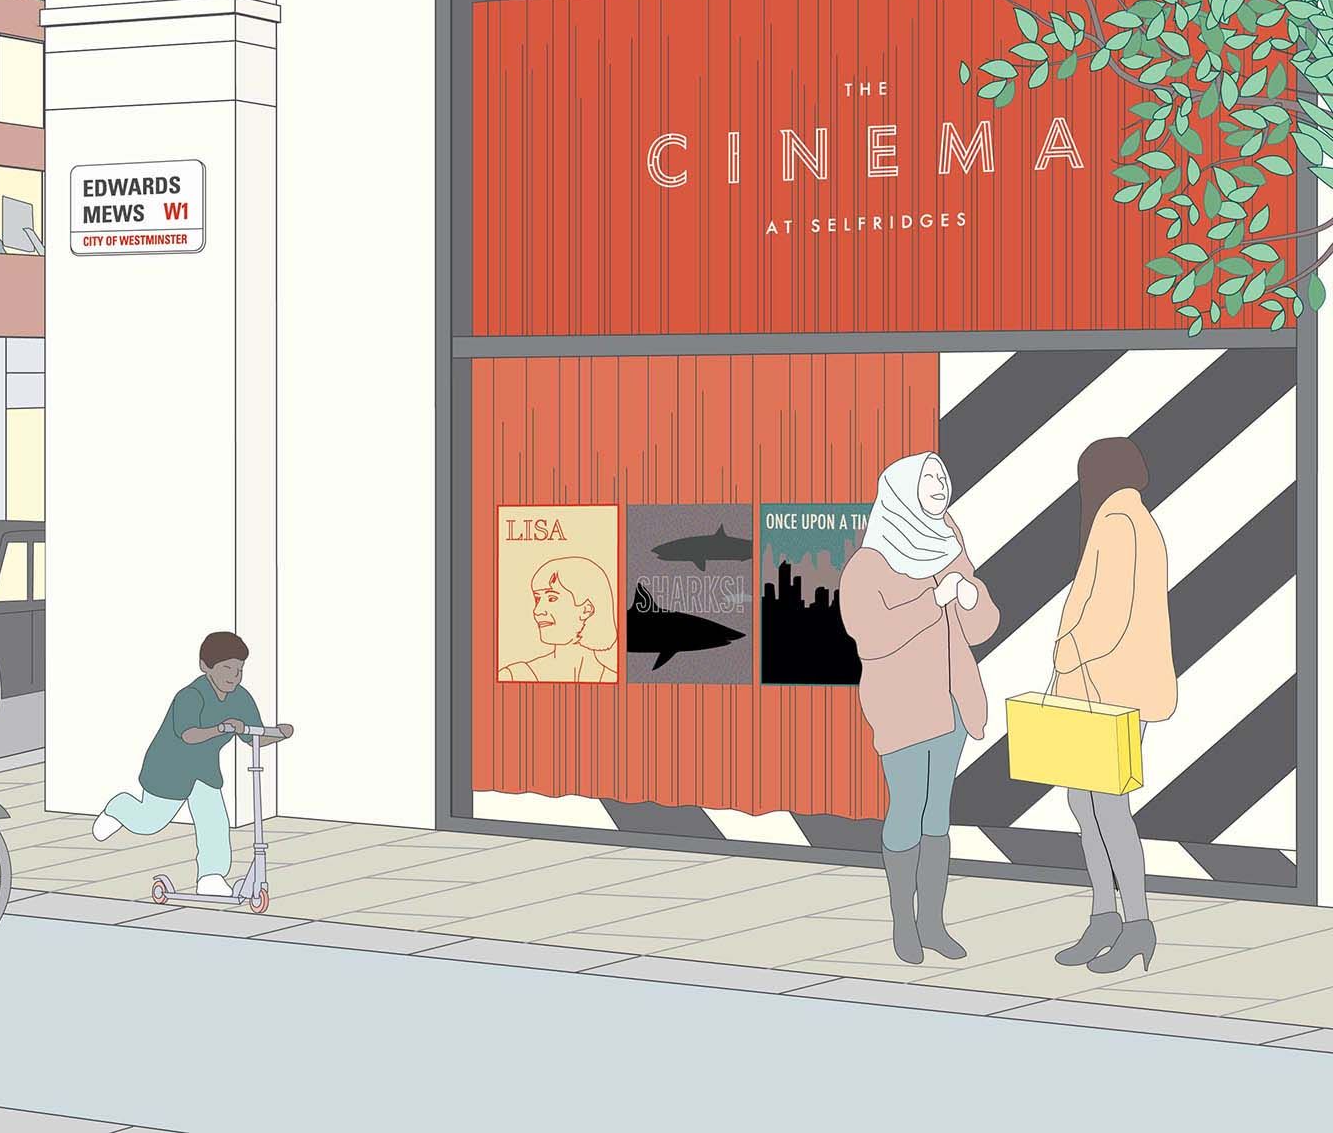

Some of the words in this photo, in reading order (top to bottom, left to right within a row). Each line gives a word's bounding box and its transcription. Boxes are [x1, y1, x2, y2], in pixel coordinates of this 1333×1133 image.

[844, 81, 889, 97] THE
[646, 117, 1084, 188] CINEMA
[83, 176, 181, 198] EDWARDS
[83, 204, 145, 224] MEWS
[163, 202, 189, 220] W1
[766, 220, 793, 234] AT
[810, 212, 967, 234] SELFRIDGES
[83, 236, 104, 247] CITY
[105, 236, 117, 246] OF
[119, 234, 188, 246] WESTMINSTER
[505, 519, 567, 542] LISA
[766, 513, 797, 530] ONCE
[802, 513, 835, 530] UPON
[839, 514, 848, 530] A
[635, 574, 745, 614] SHARKS!
